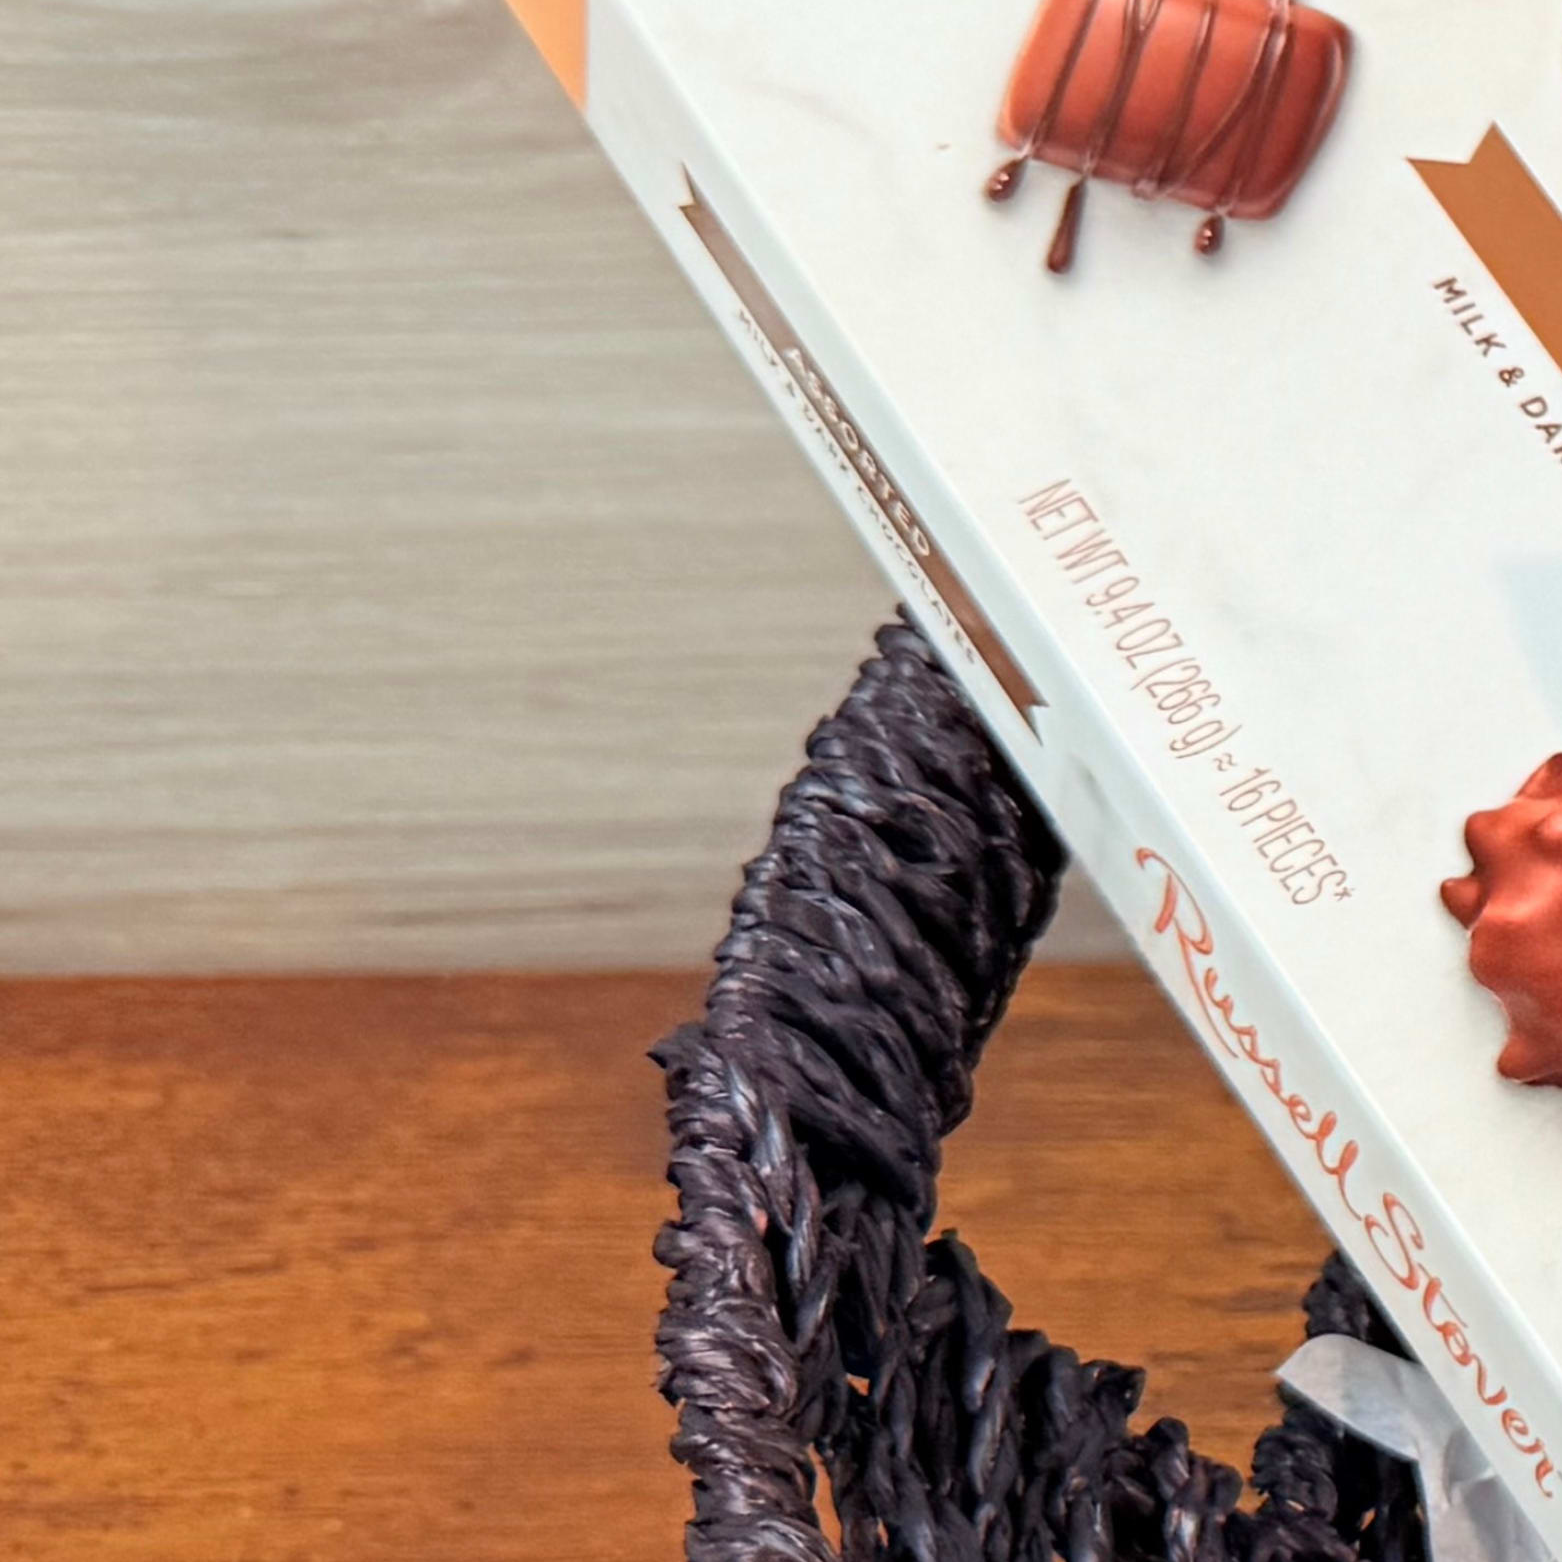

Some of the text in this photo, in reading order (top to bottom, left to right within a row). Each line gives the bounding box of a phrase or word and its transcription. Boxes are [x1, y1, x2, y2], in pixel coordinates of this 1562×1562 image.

[1433, 275, 1507, 359] MILK
[1498, 365, 1526, 388] &
[782, 347, 930, 557] ASSORTED
[1017, 478, 1099, 541] NET
[1055, 528, 1129, 585] WT
[1085, 575, 1156, 630] 9.4
[1115, 617, 1185, 671] OZ
[1218, 766, 1283, 813] 16
[1135, 846, 1363, 1221] Russell
